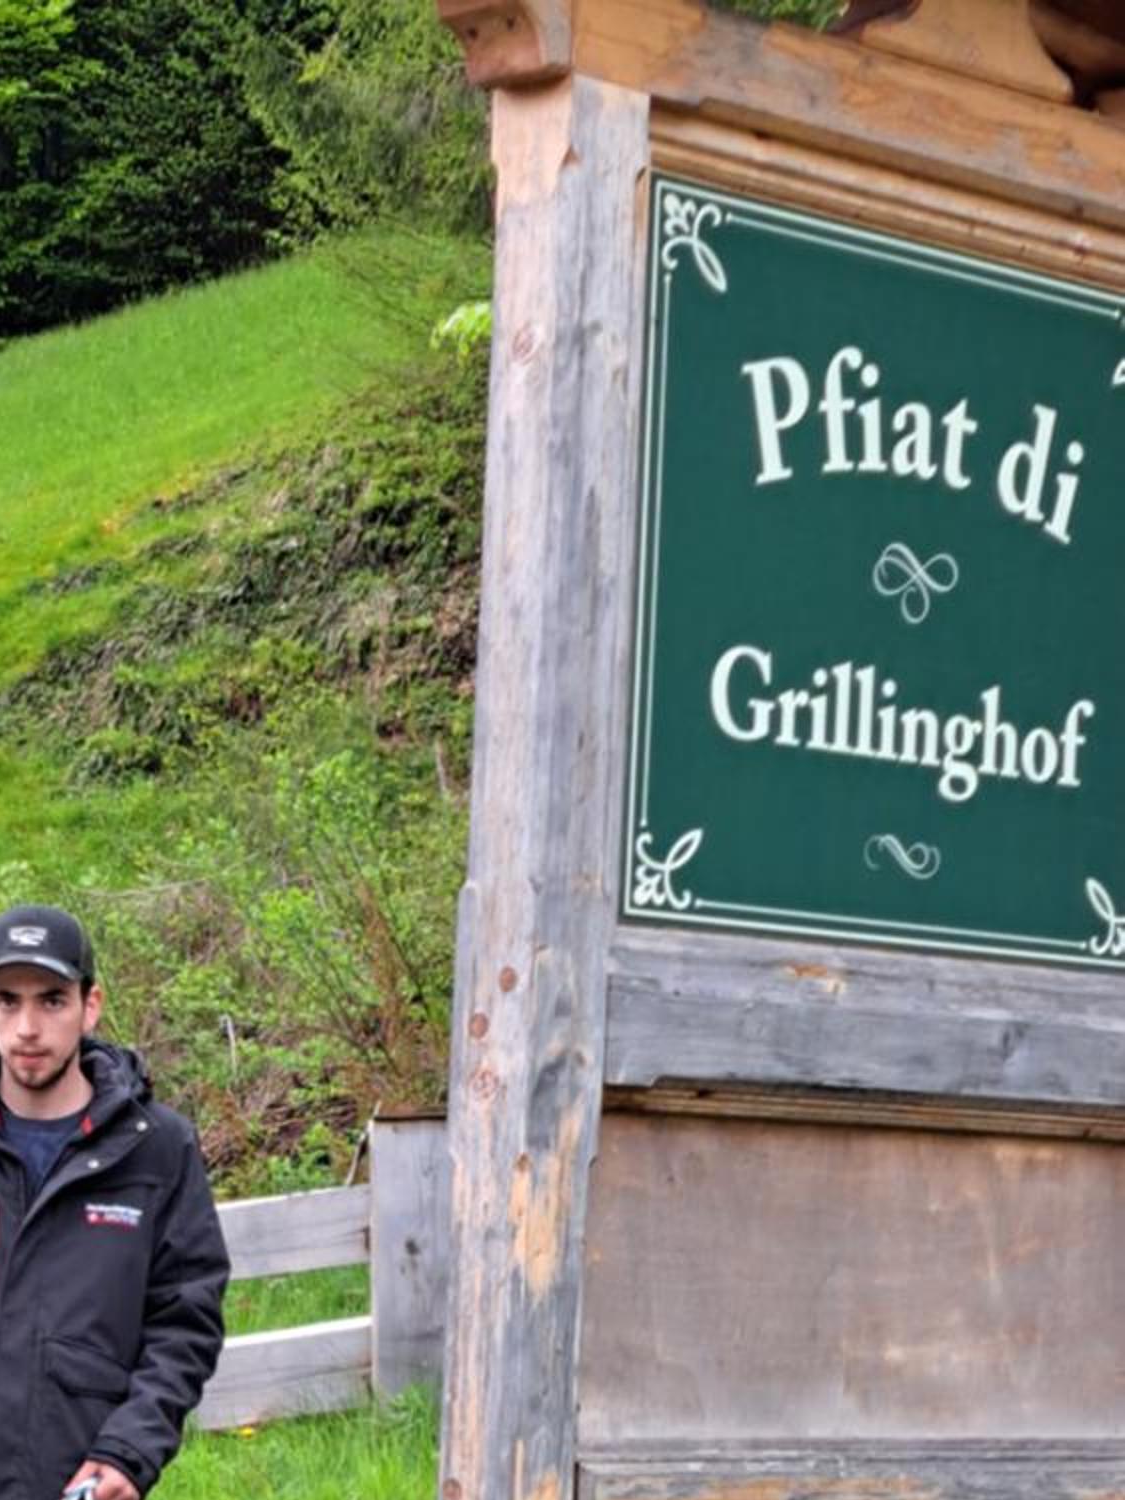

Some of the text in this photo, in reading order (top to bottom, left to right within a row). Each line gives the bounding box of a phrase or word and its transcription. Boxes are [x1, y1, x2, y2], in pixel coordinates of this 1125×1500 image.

[741, 346, 1086, 545] Pfiat di
[710, 644, 1095, 803] Grillinghof
